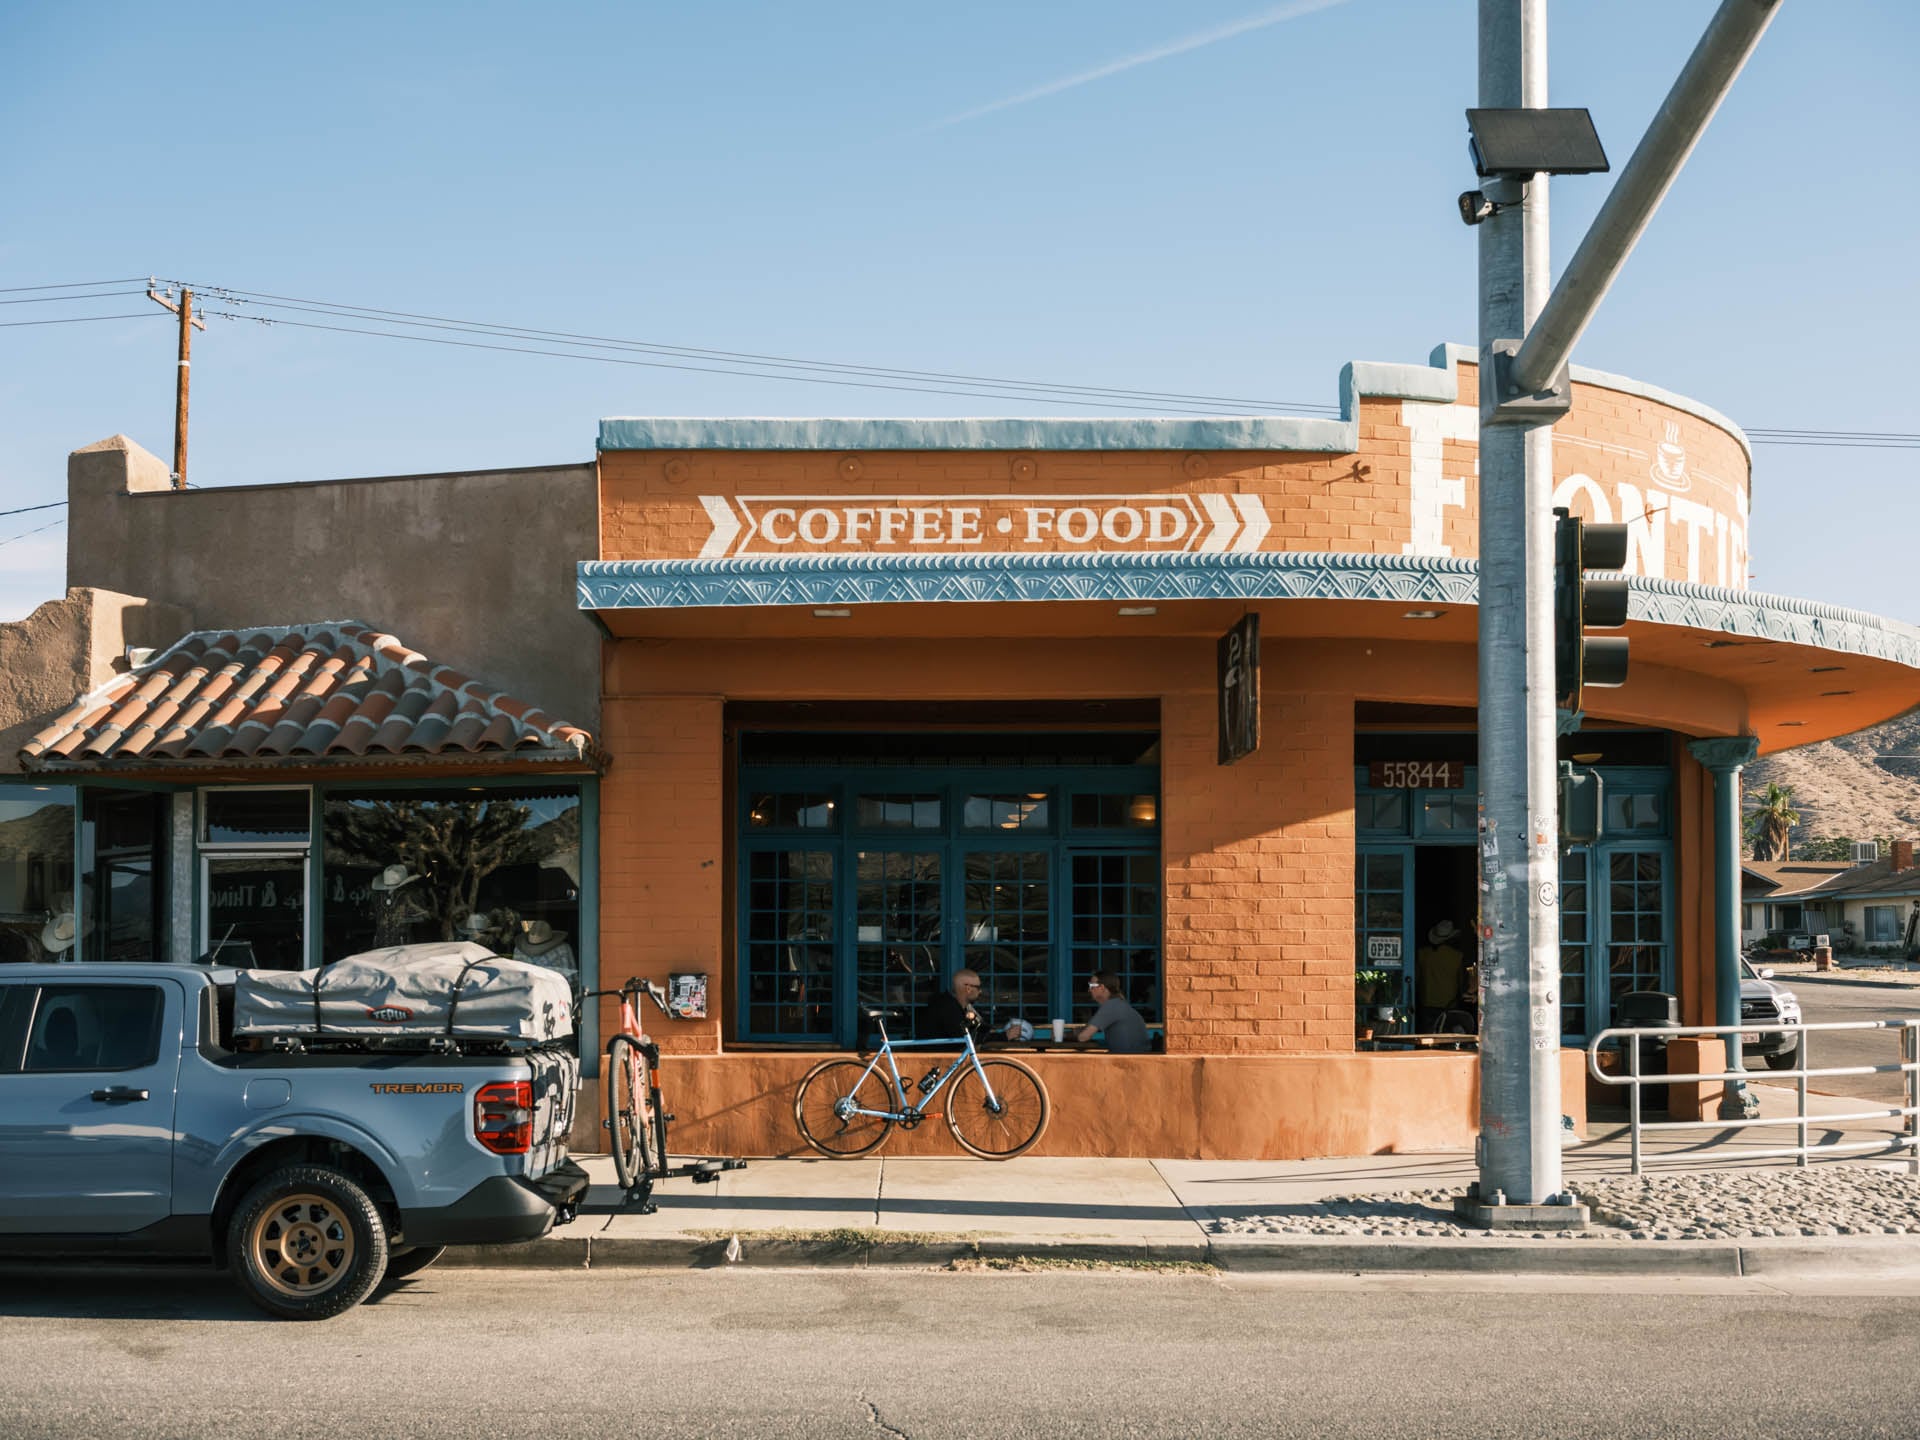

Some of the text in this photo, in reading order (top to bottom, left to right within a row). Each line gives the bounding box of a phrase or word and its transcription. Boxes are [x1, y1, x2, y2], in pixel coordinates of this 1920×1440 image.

[759, 507, 1189, 545] COFFEE FOOD
[1383, 761, 1450, 788] 55844
[1370, 943, 1399, 957] OPEN
[369, 1083, 464, 1095] TREMOR
